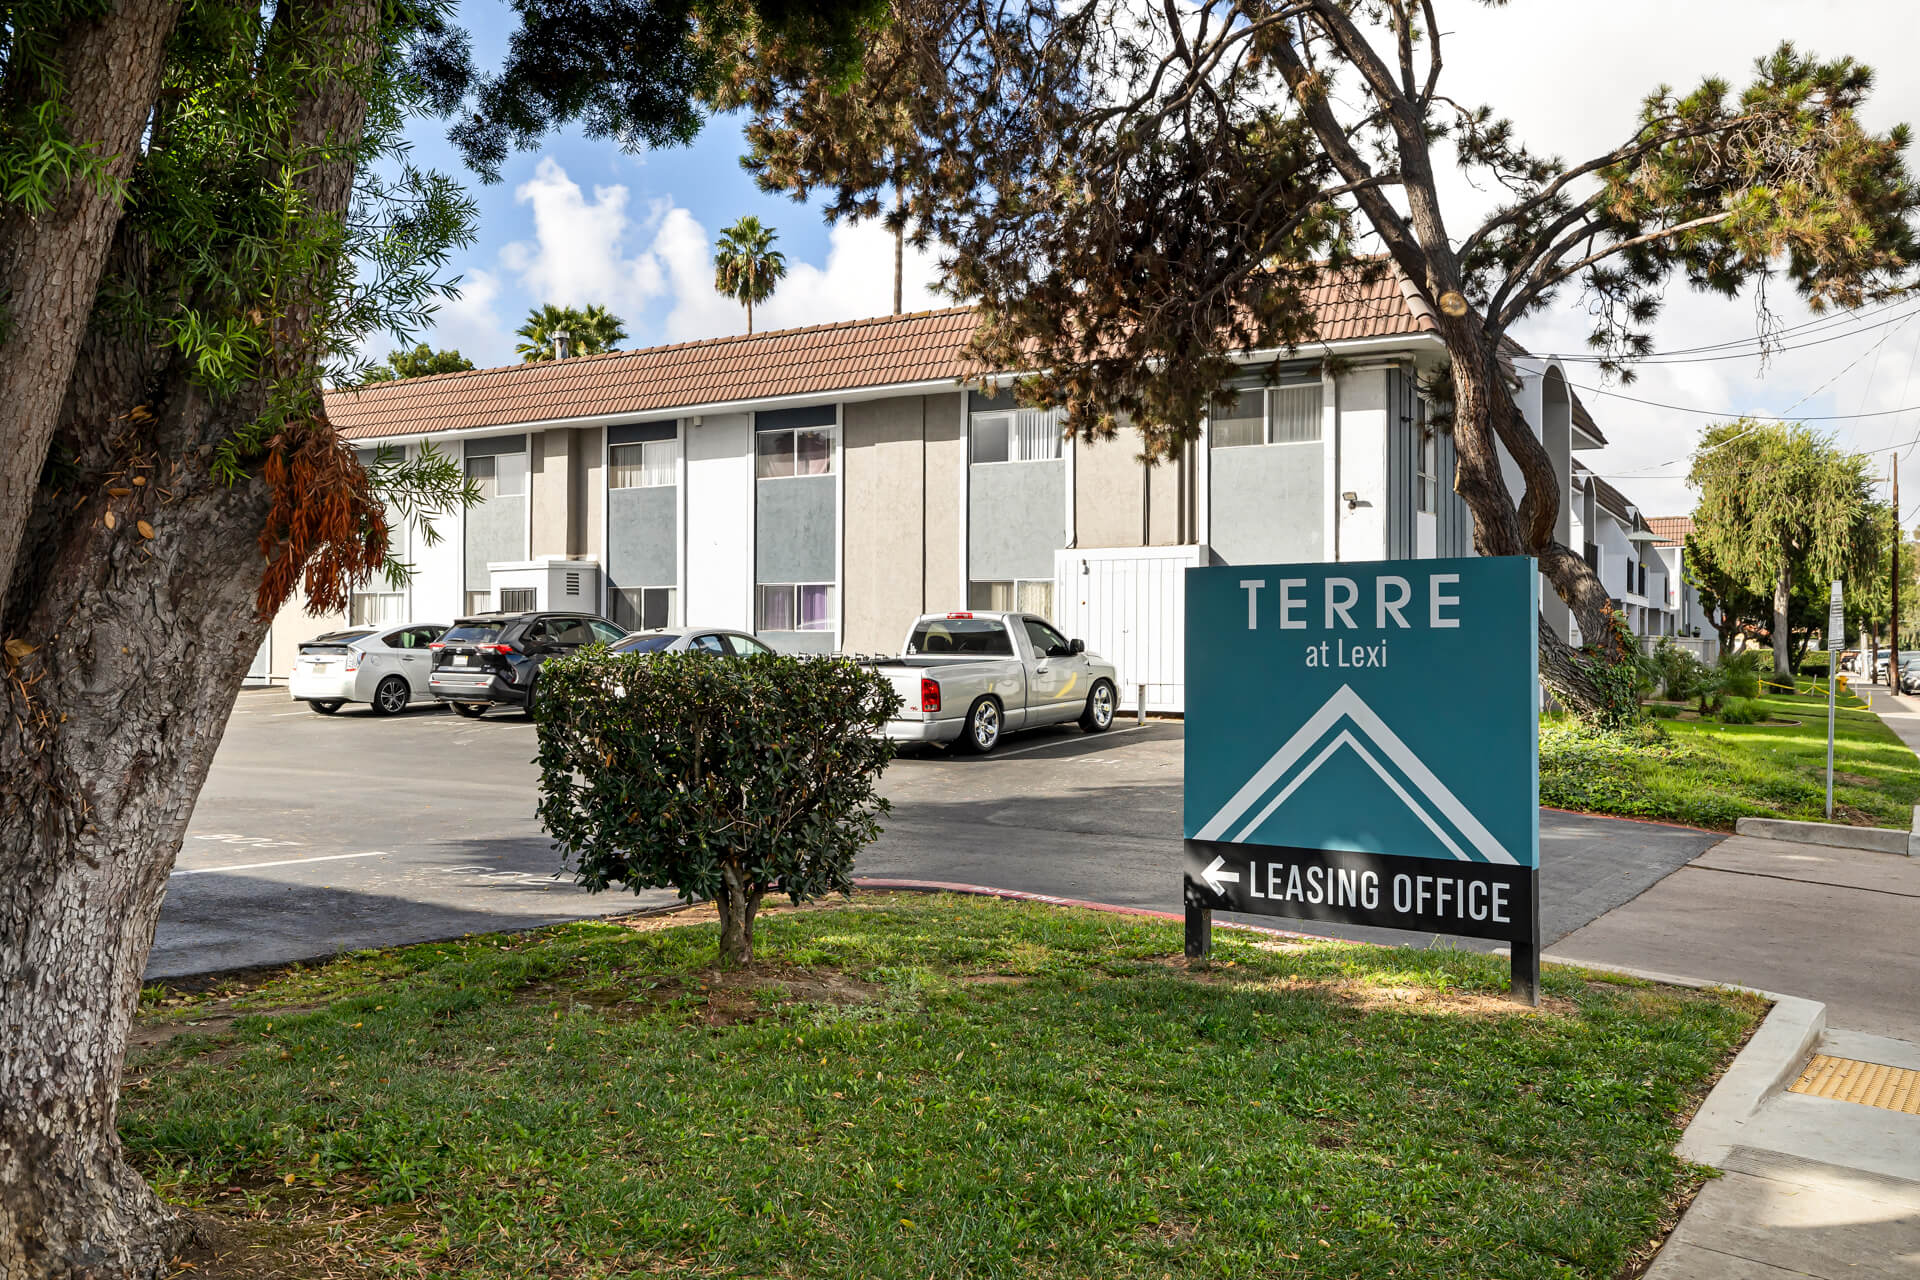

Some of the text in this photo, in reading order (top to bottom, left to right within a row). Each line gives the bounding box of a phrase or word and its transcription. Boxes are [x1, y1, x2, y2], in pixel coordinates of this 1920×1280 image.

[1240, 574, 1459, 629] TERRE
[1306, 639, 1386, 667] at Lexi
[1250, 860, 1510, 922] LEASING OFFICE
